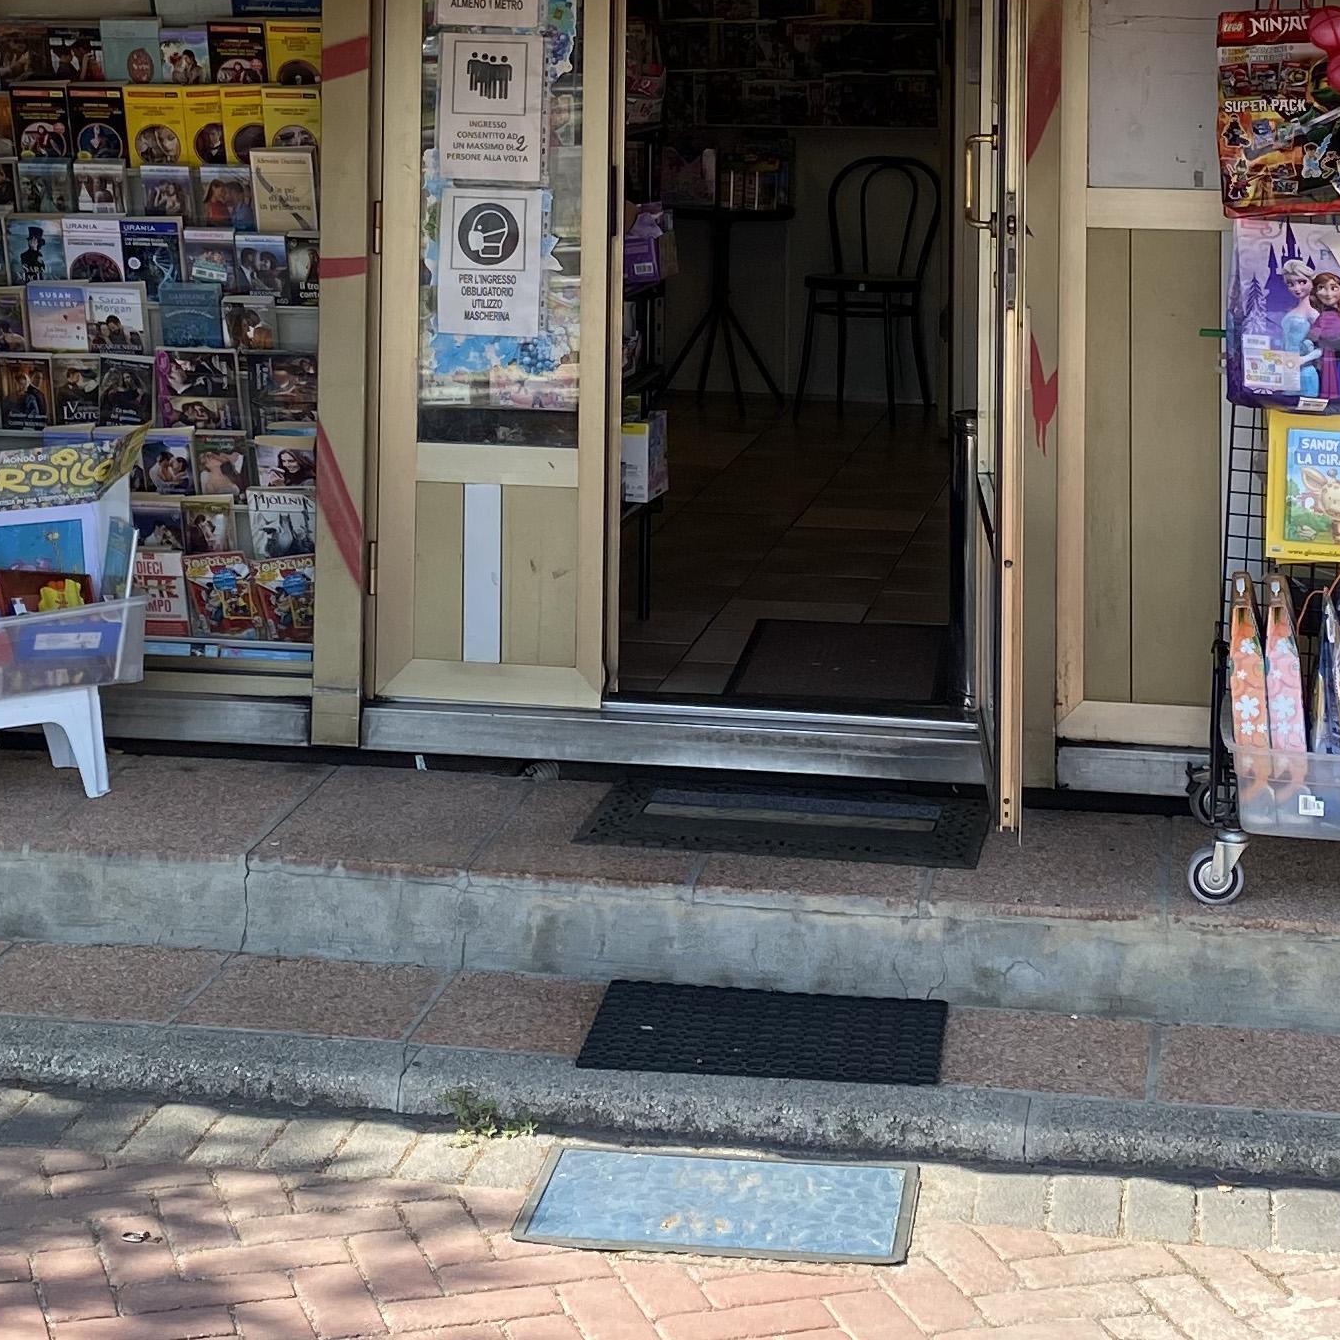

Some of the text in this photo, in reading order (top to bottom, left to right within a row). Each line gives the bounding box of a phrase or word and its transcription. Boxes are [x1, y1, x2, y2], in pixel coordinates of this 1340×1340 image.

[495, 0, 524, 11] METRO
[1225, 99, 1307, 112] SUPER PACK
[469, 120, 507, 129] INGRESSO
[457, 131, 506, 140] CONSENTITO
[447, 153, 481, 161] PERSONE
[503, 155, 529, 163] VOLTA
[123, 224, 156, 232] URANIA
[459, 274, 517, 285] PER L'INGRESSO
[39, 291, 72, 299] SUSAN
[461, 286, 514, 297] OBBLIGATORIO
[33, 300, 79, 308] MALLERY
[472, 299, 503, 309] UTILIZZO
[464, 310, 510, 321] MASCHERINA
[1301, 437, 1340, 452] SANDY
[3, 456, 36, 466] MONDO
[1296, 453, 1312, 464] LA
[135, 561, 164, 575] DIECI
